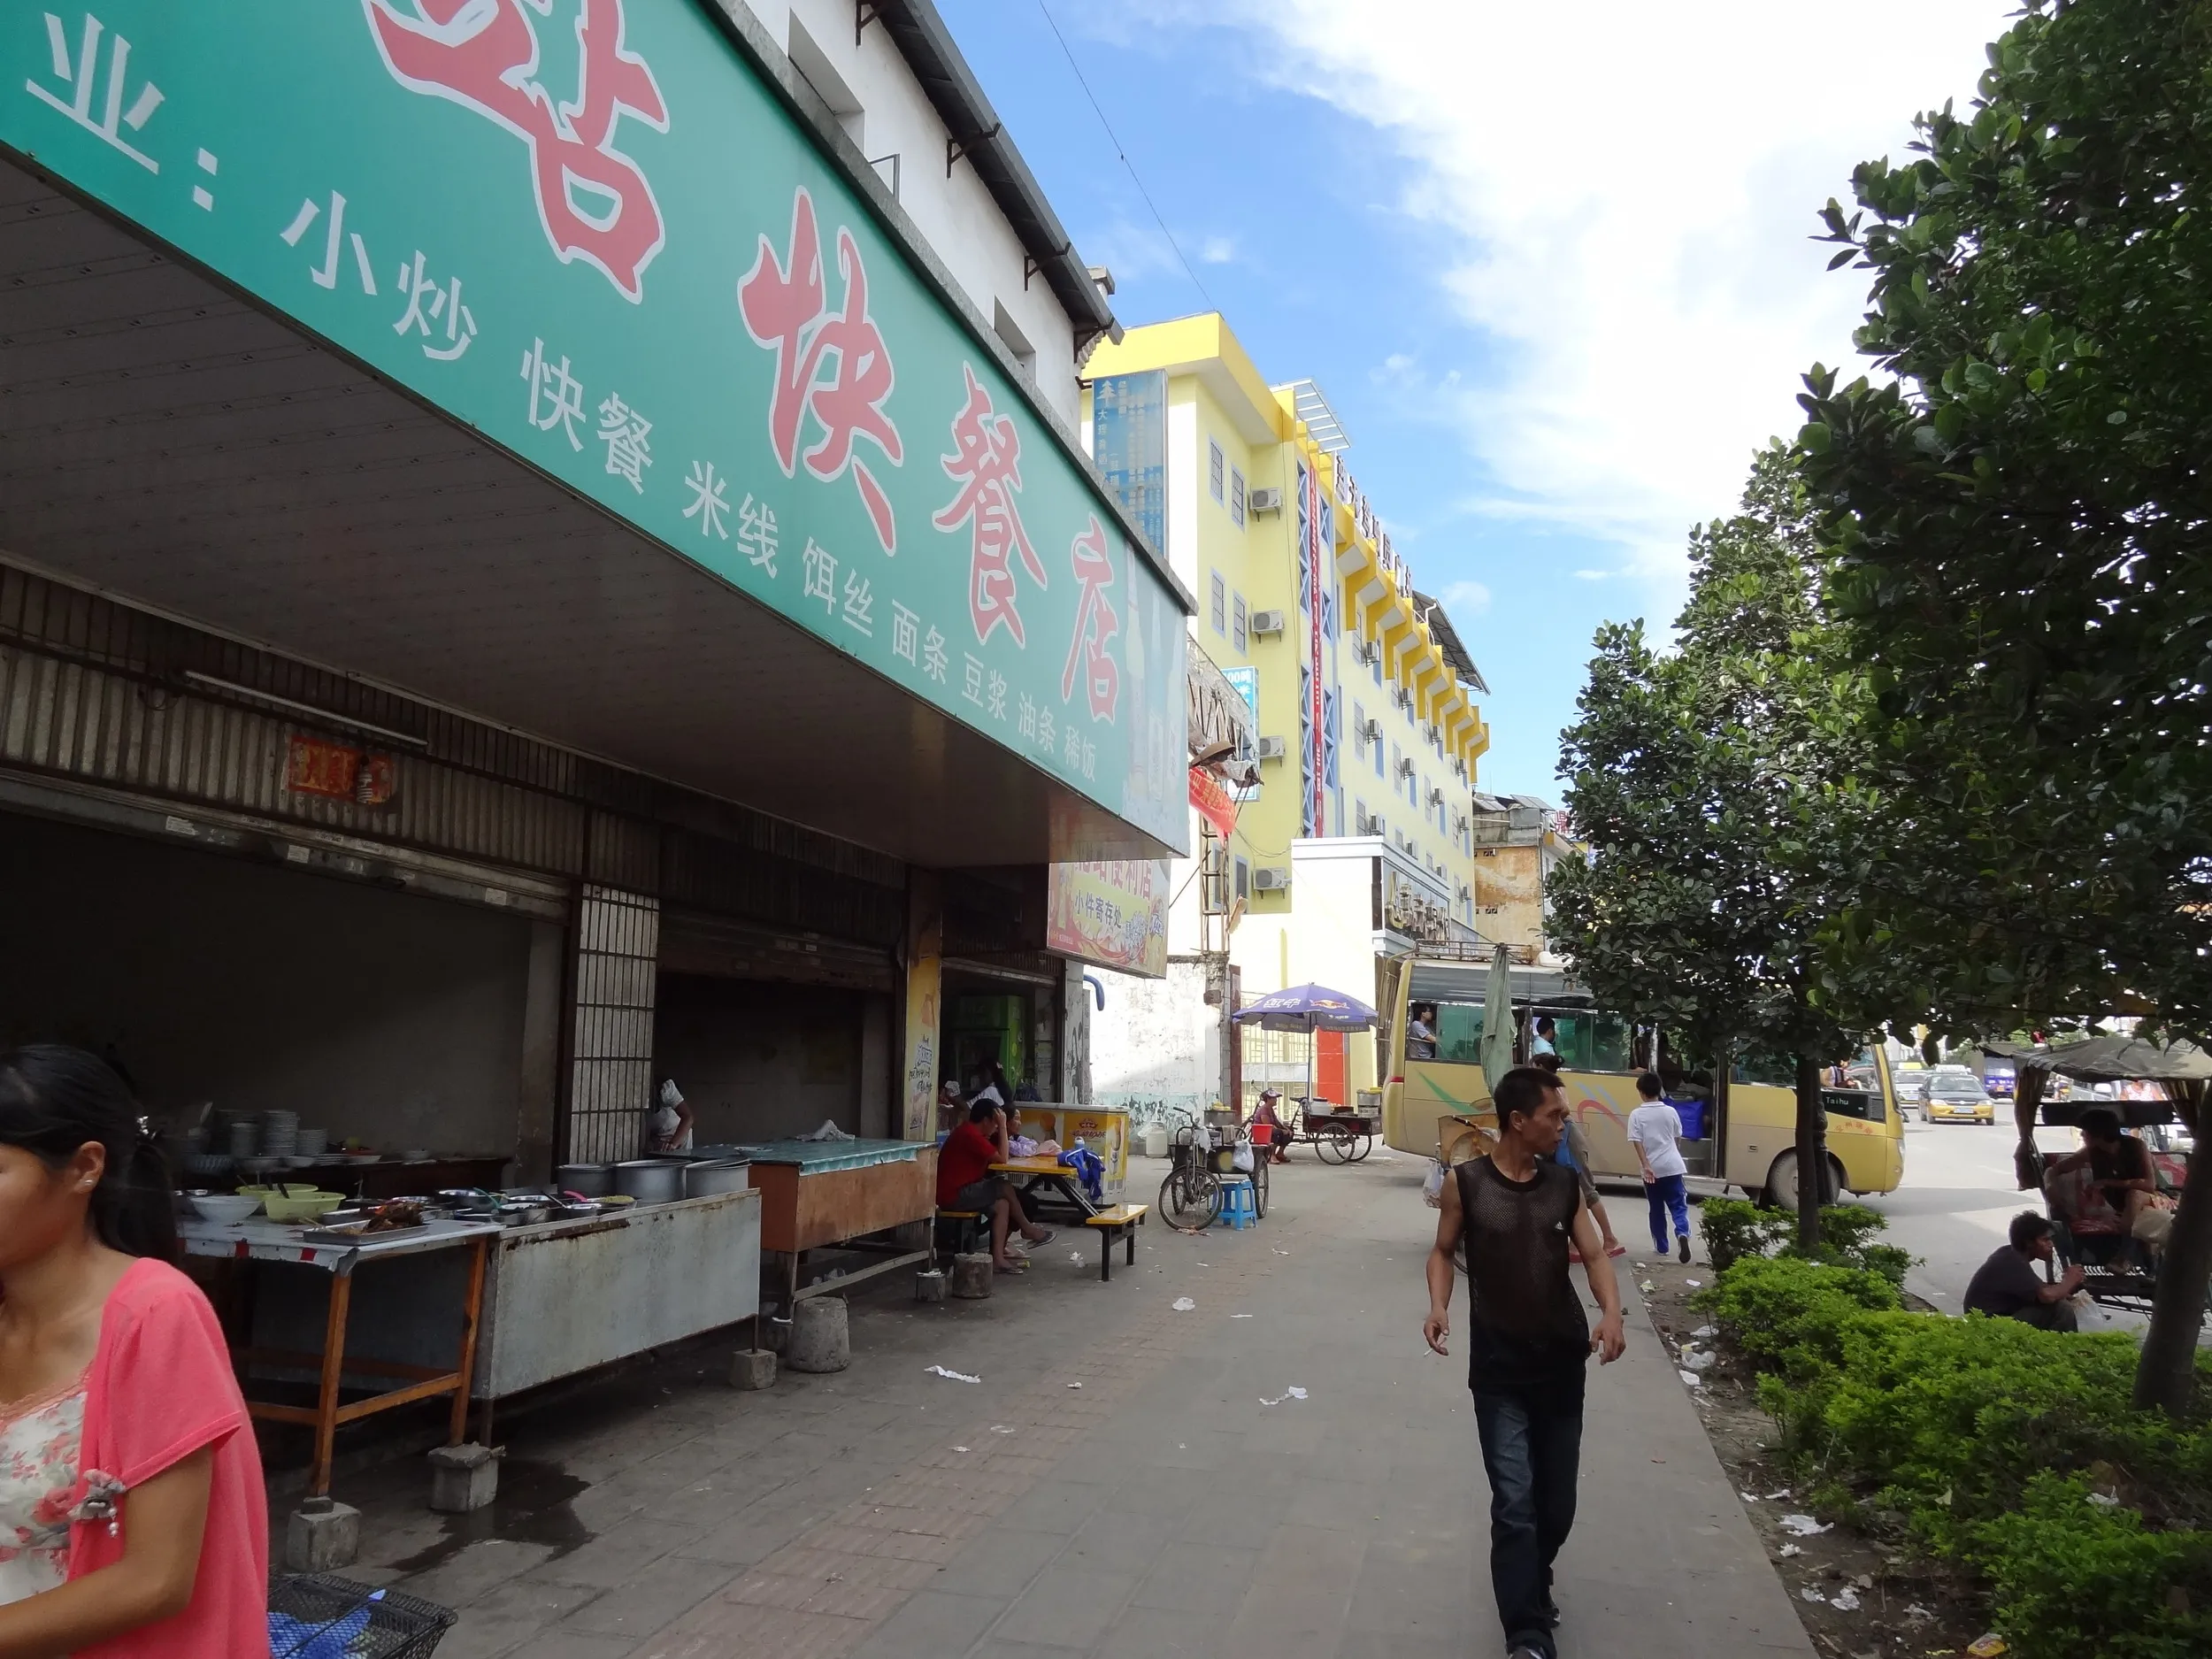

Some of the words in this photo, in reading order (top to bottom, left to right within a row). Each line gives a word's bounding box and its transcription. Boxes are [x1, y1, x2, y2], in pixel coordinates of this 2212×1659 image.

[280, 190, 478, 361] 小炒
[519, 335, 653, 495] 快餐
[680, 460, 779, 580] 米线
[803, 536, 873, 638] 饵丝
[892, 599, 949, 685] 面条
[962, 650, 1007, 721] 豆浆
[1018, 691, 1056, 754] 油条
[1064, 726, 1096, 782] 稀饭
[1074, 888, 1122, 930] 小件寄存处
[1263, 997, 1302, 1009] 红牛
[1826, 1096, 1849, 1105] Taihu
